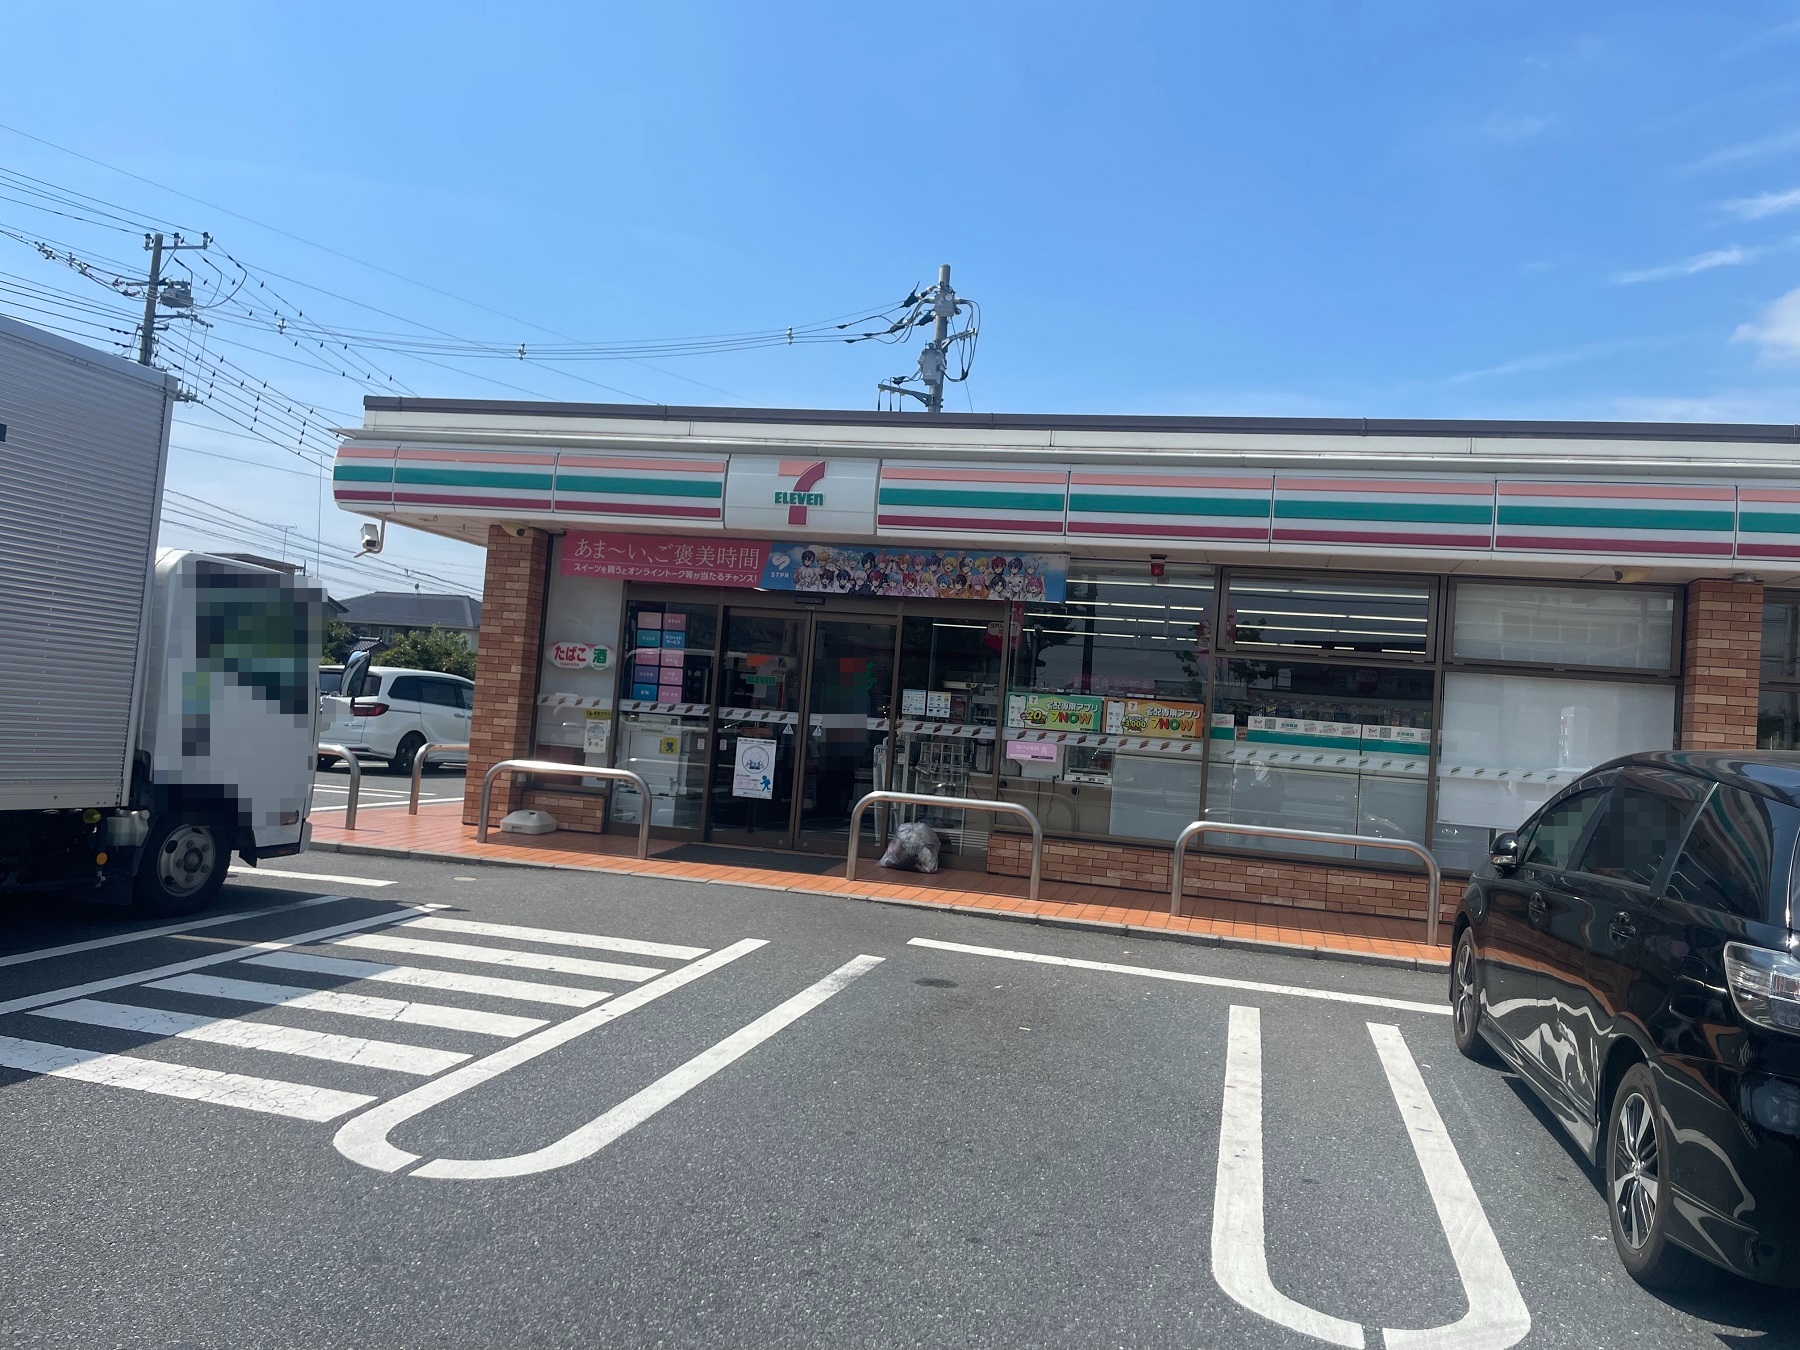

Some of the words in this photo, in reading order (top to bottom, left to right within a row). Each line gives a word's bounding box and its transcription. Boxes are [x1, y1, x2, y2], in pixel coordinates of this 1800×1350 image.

[778, 460, 826, 525] 7
[770, 571, 790, 580] STPR
[554, 645, 587, 662] たばこ
[592, 648, 608, 664] 酒
[1046, 701, 1099, 713] 宅配専用アプリ
[1145, 706, 1201, 719] 宅配専用アプリ
[1051, 711, 1093, 725] 7NOW
[1150, 717, 1195, 731] 7NOW
